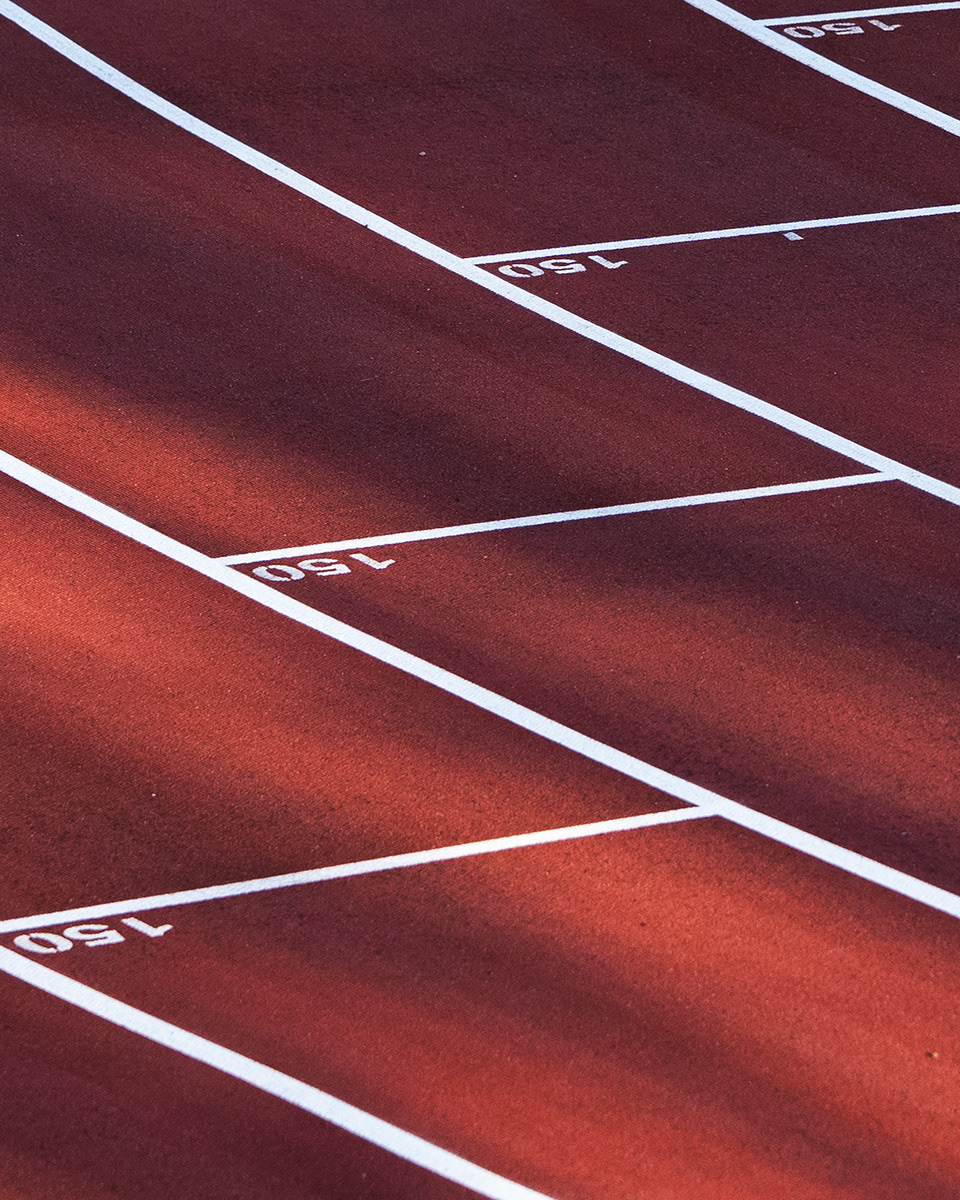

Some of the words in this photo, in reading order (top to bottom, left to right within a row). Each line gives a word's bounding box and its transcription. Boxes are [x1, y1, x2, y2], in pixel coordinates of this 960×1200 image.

[783, 19, 902, 39] 150
[498, 255, 629, 278] 150
[252, 553, 396, 582] 150
[13, 917, 173, 954] 150
